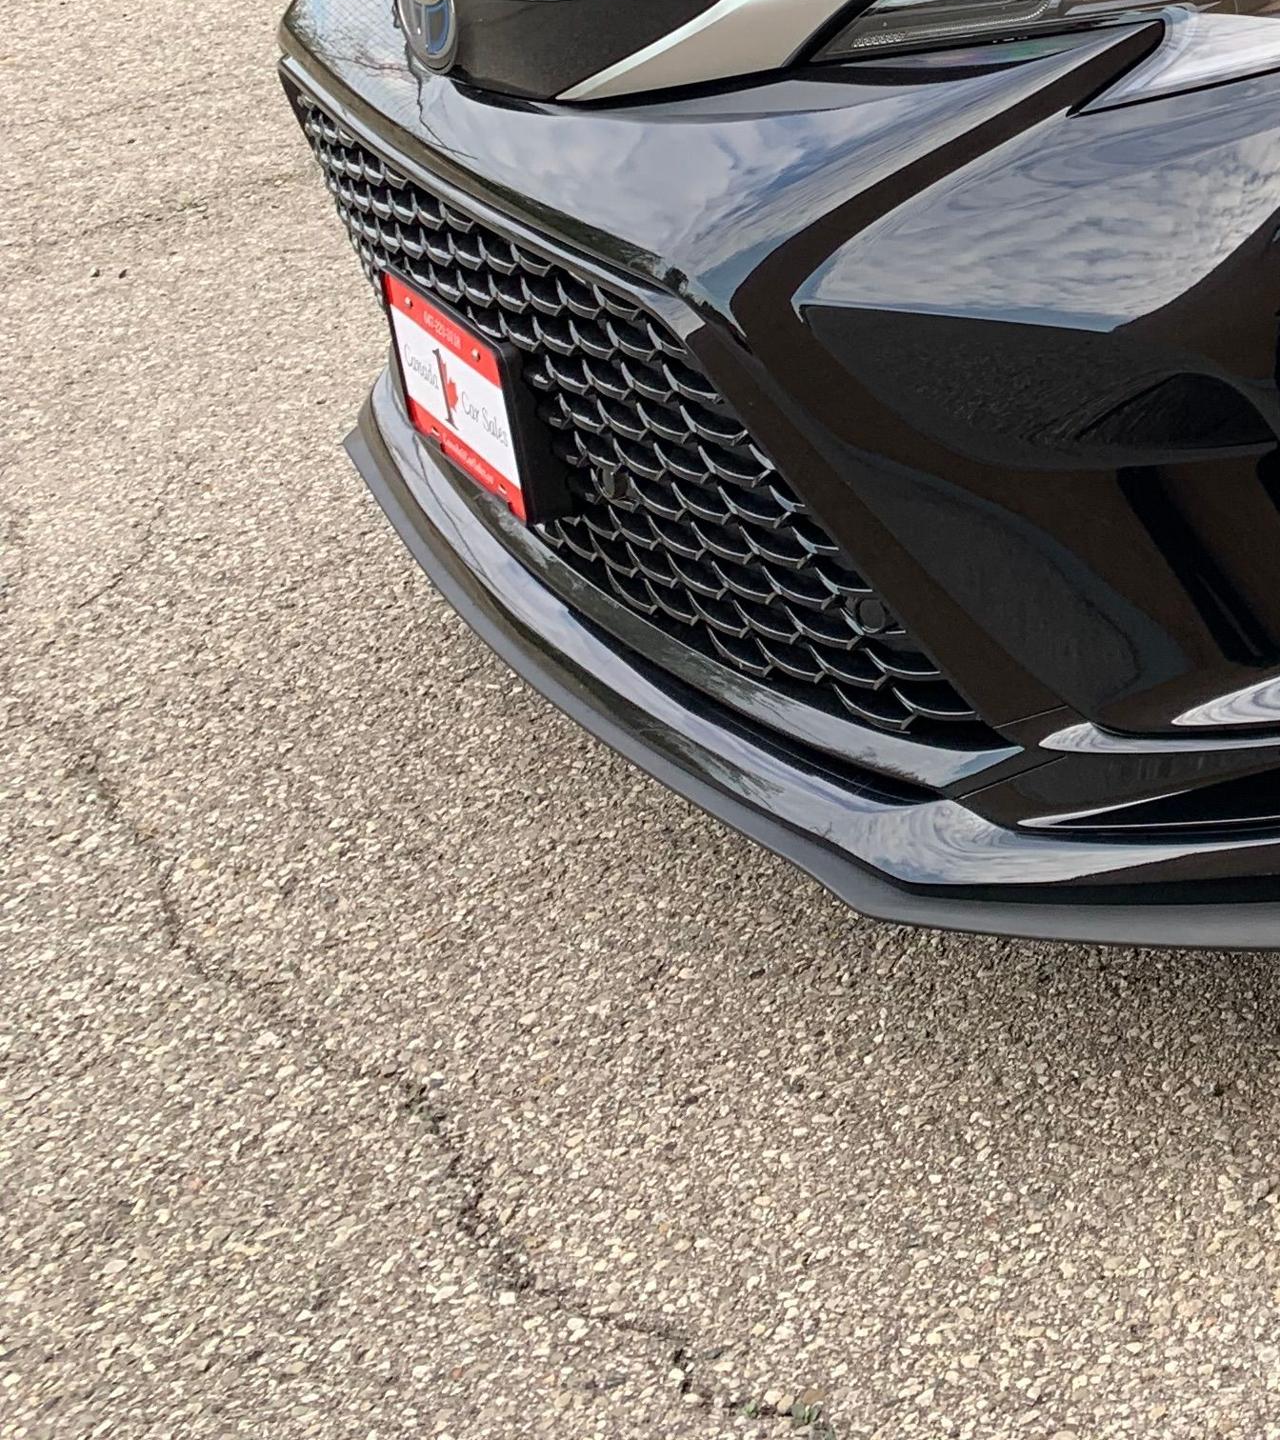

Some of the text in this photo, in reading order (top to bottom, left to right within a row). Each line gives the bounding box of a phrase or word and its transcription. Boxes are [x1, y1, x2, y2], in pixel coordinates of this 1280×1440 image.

[404, 343, 440, 390] Canada
[461, 391, 480, 422] Car
[481, 407, 508, 448] Sales
